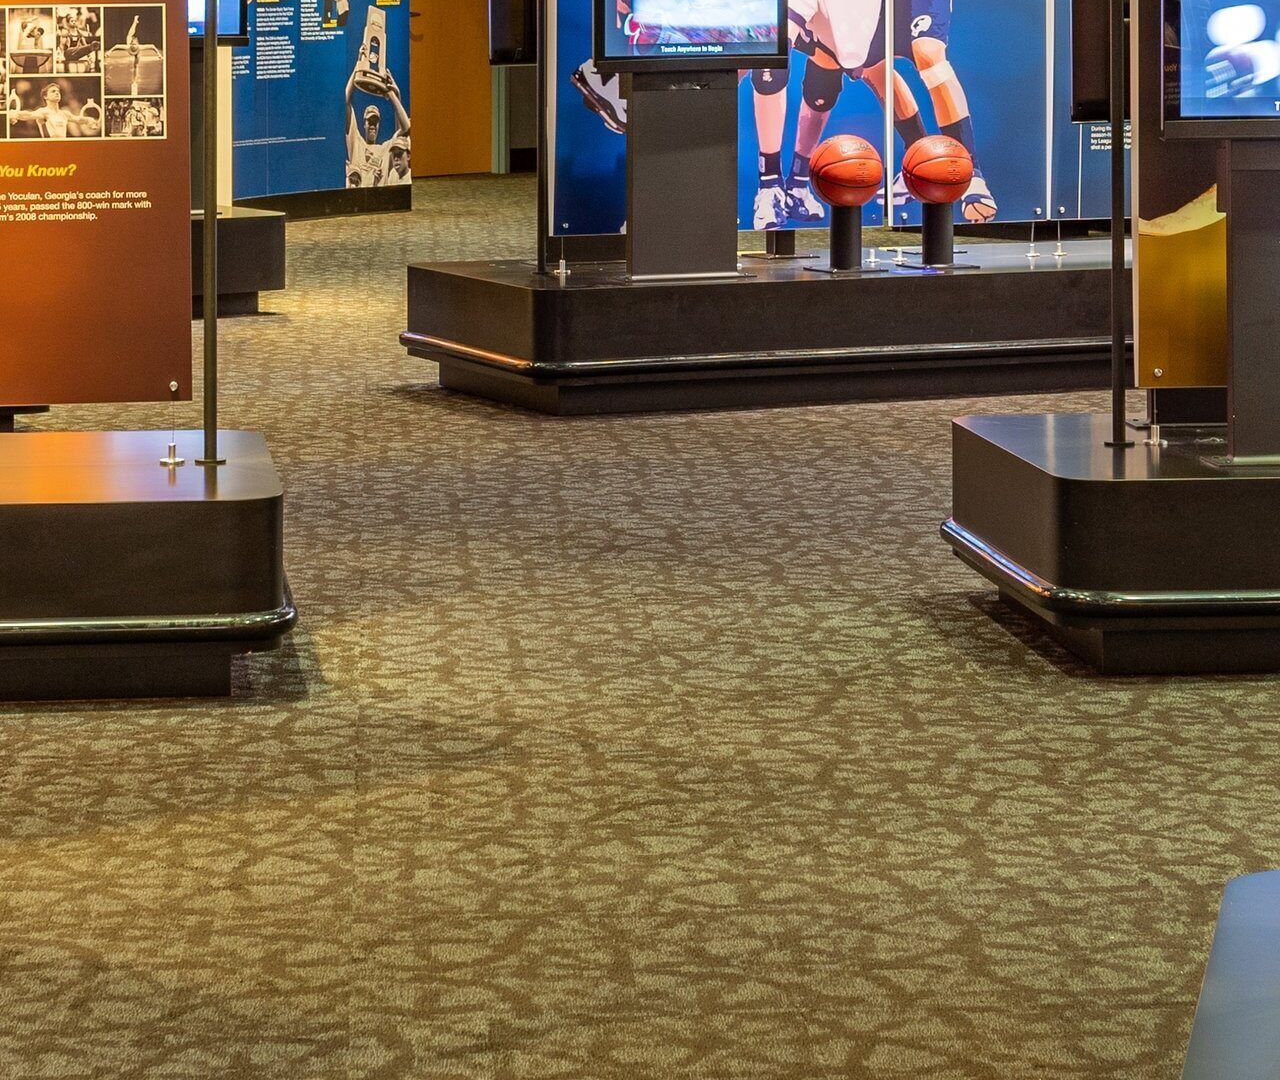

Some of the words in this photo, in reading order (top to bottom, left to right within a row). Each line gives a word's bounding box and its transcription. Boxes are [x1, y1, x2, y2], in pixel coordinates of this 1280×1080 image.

[661, 45, 677, 53] Touch
[0, 165, 24, 178] You
[27, 164, 77, 177] Know?
[8, 191, 42, 202] Yoculan,
[45, 190, 83, 203] Georgia's
[86, 190, 110, 200] coach
[113, 190, 123, 200] for
[126, 192, 147, 200] more
[4, 204, 28, 214] years,
[30, 201, 60, 213] passed
[62, 201, 75, 210] the
[77, 200, 109, 210] 800-win
[112, 200, 132, 210] mark
[134, 200, 151, 209] with
[16, 212, 36, 222] 2008
[38, 211, 97, 224] championship.
